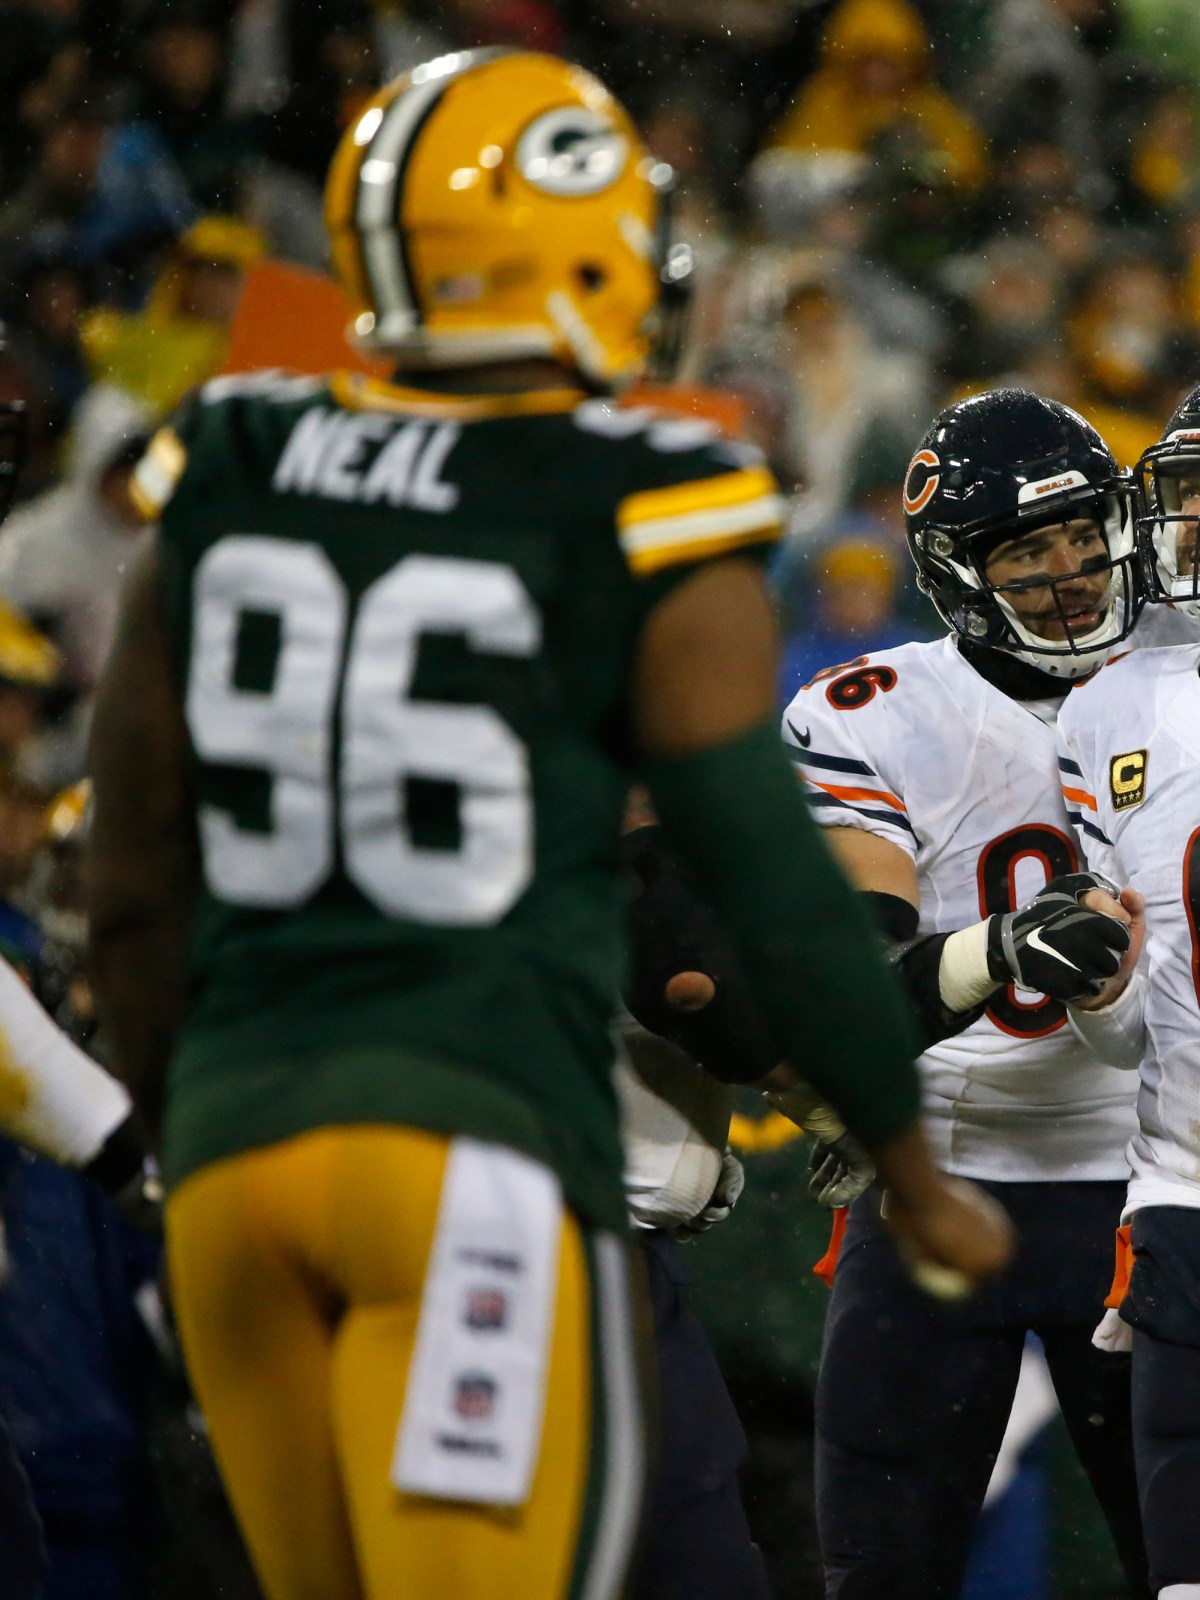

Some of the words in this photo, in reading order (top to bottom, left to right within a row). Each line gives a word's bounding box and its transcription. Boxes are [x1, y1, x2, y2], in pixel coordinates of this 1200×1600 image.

[273, 407, 463, 512] NEAL
[902, 449, 940, 515] C
[186, 535, 543, 928] 96
[1112, 753, 1144, 794] C
